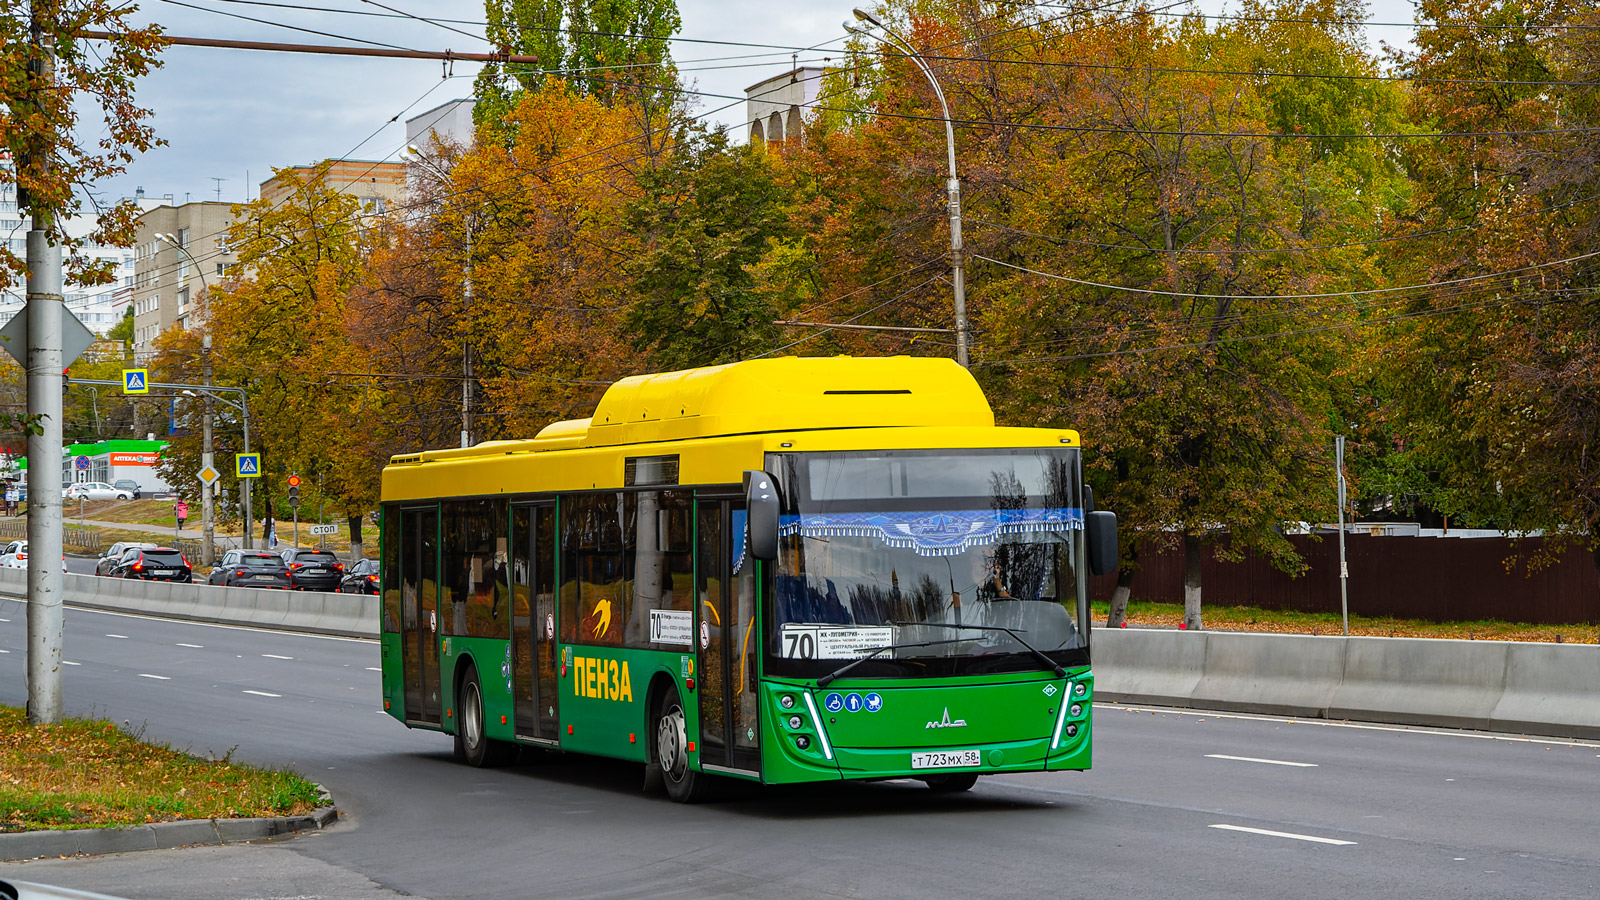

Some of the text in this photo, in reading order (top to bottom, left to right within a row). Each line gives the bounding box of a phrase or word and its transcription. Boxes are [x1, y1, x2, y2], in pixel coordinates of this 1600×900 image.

[313, 525, 335, 534] СТОП
[651, 613, 661, 639] 70
[784, 633, 815, 660] 70
[574, 656, 633, 702] ПЕНЗА
[965, 752, 976, 761] 58
